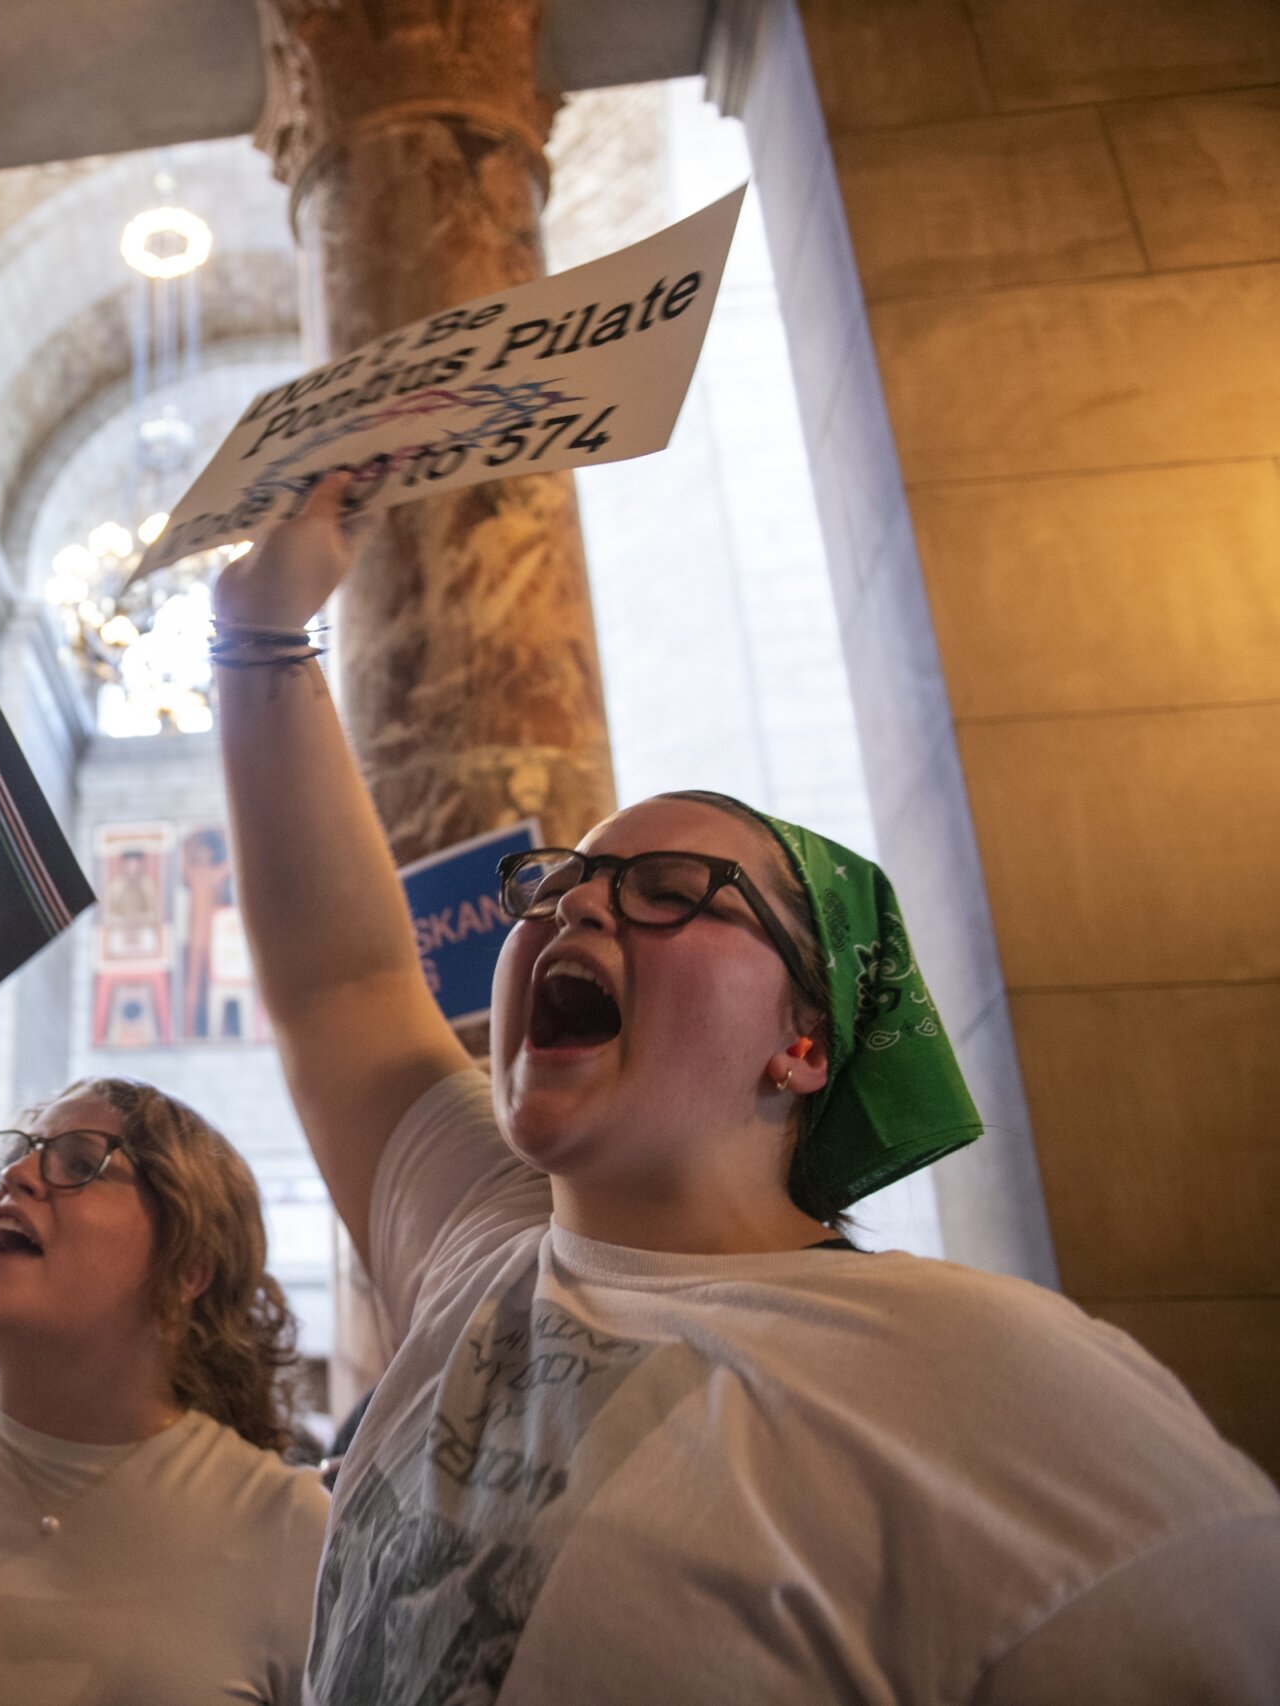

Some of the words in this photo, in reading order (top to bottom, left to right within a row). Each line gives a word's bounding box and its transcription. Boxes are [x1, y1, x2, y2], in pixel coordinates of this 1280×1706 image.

[410, 303, 508, 350] Be
[241, 347, 479, 460] Pontius
[482, 270, 703, 371] Pilate
[483, 405, 619, 467] 574
[414, 895, 511, 950] SKAN
